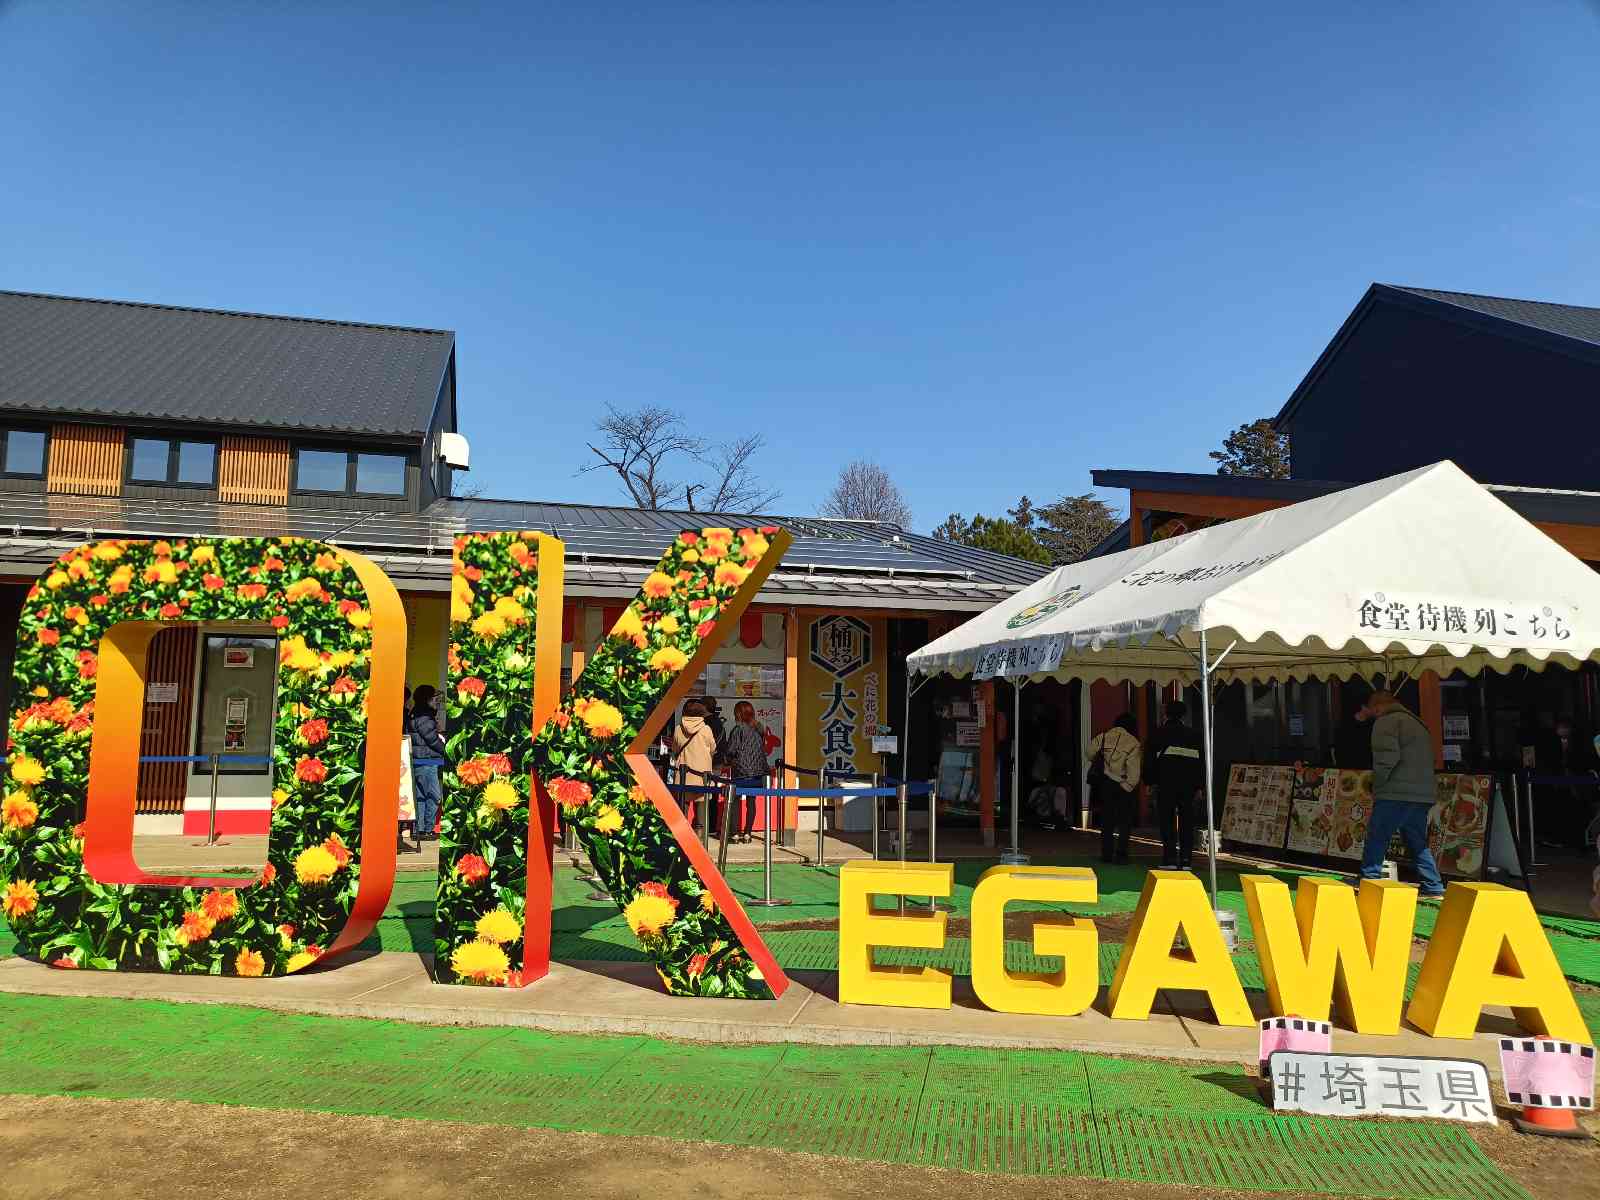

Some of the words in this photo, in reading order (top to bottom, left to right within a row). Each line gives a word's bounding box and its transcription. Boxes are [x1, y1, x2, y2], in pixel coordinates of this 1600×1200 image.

[1356, 598, 1572, 641] 食堂待機列こちら
[1277, 1061, 1489, 1118] #埼玉県
